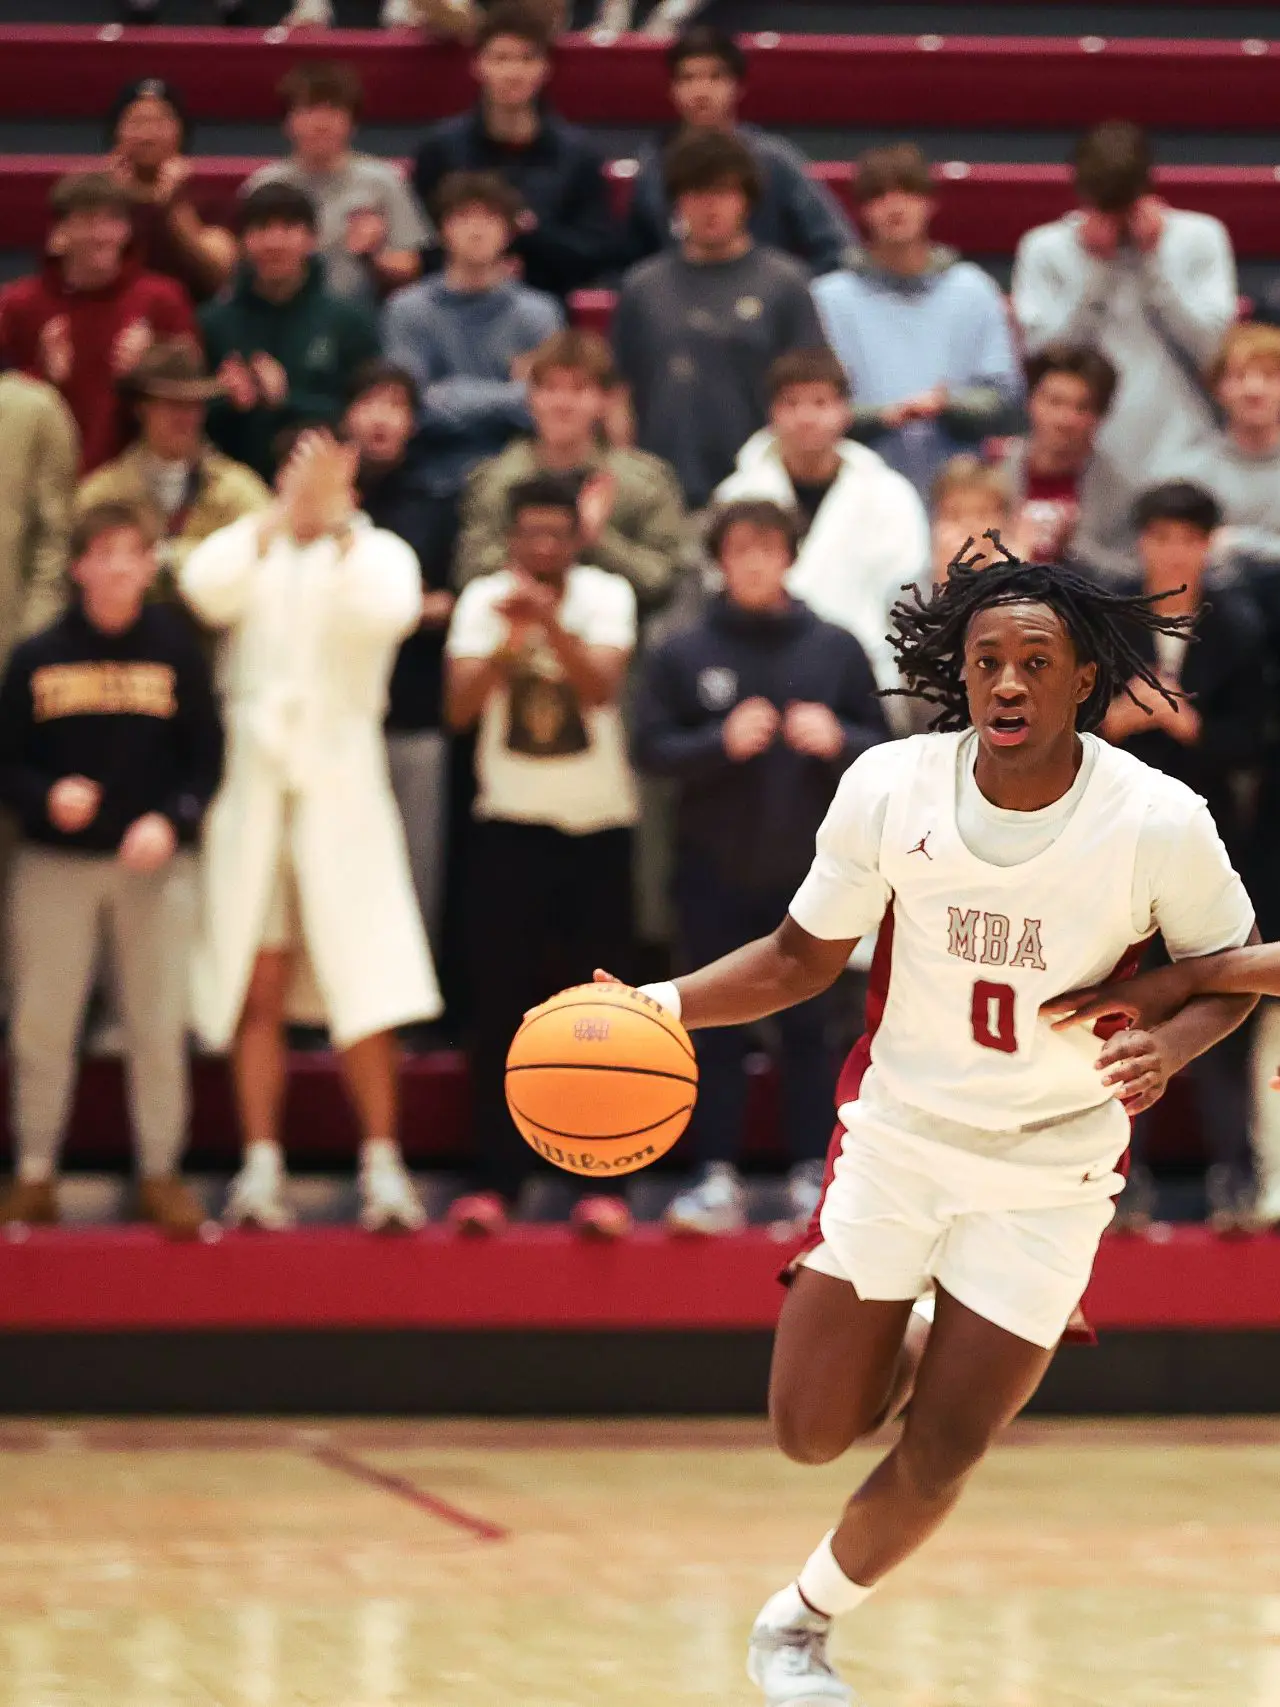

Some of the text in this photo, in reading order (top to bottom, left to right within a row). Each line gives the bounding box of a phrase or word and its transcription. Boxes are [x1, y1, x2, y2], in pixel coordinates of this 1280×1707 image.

[947, 906, 1046, 970] MBA
[970, 979, 1018, 1054] 0
[532, 1133, 655, 1170] Wilson
